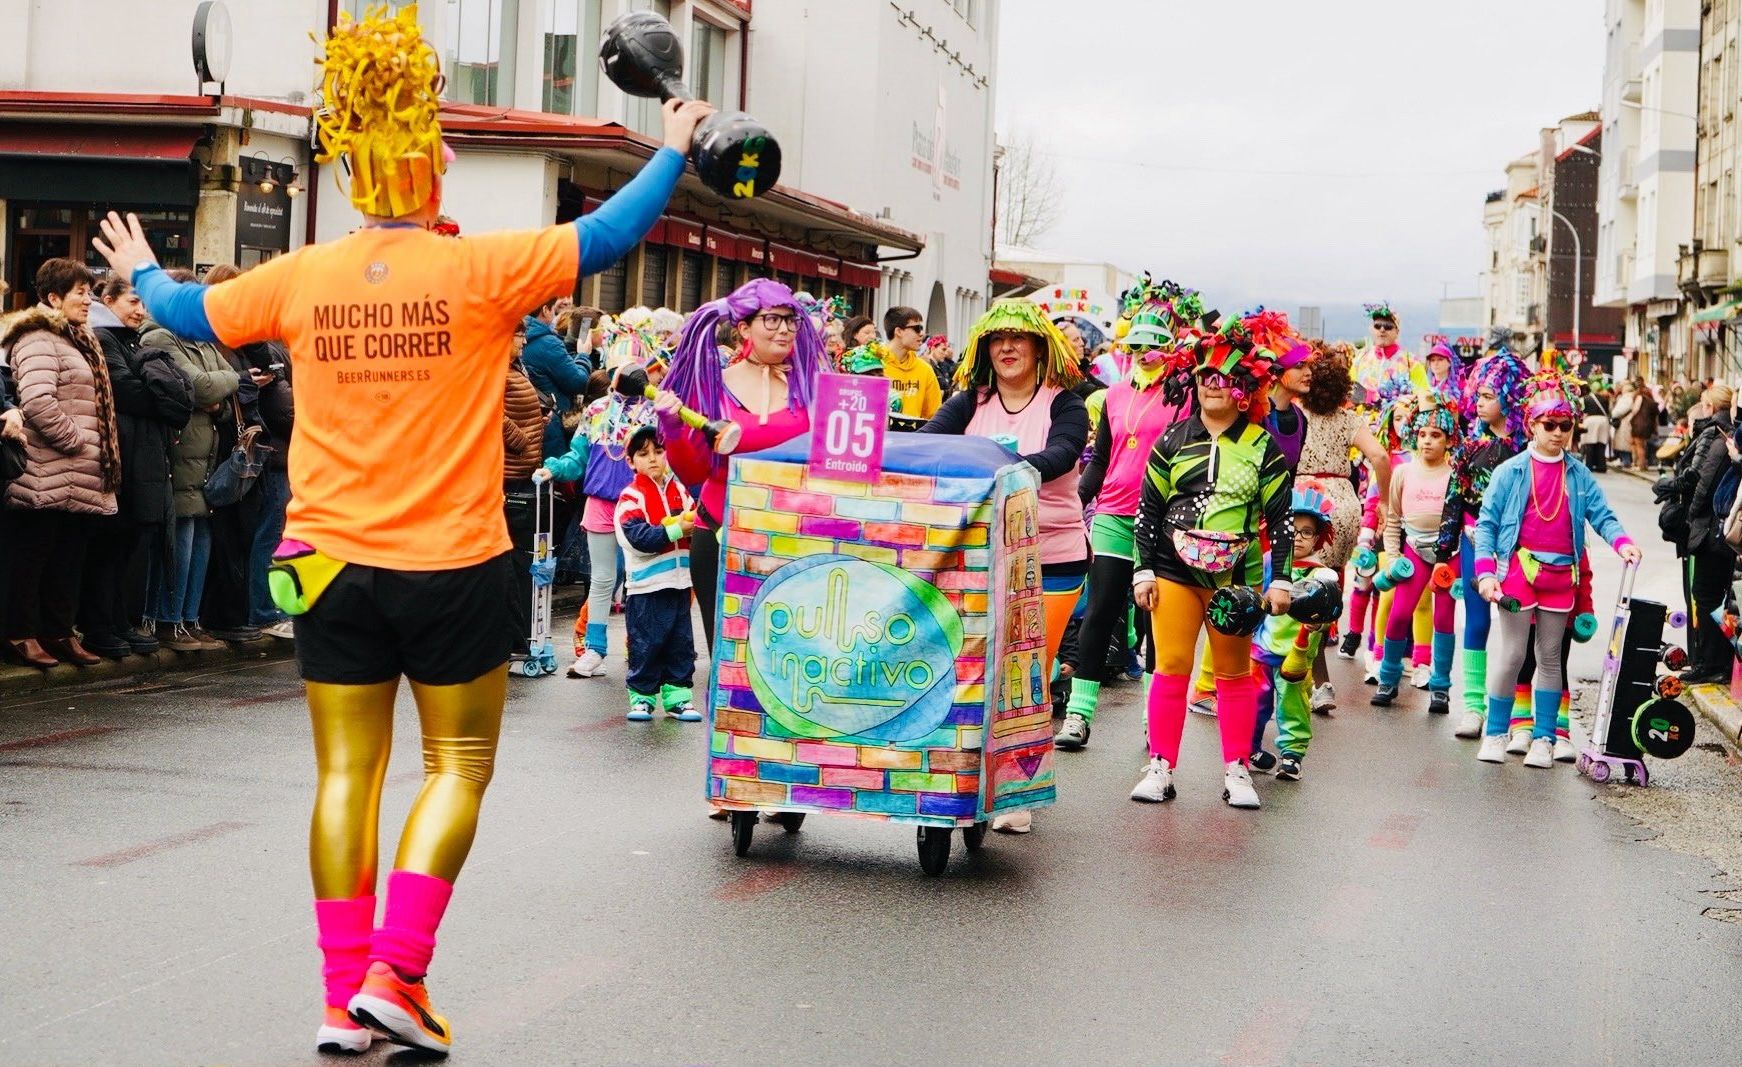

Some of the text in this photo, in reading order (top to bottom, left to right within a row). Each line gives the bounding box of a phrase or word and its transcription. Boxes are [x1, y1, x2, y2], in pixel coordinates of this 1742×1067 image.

[314, 294, 450, 330] MUCHO MÁS
[315, 331, 452, 362] QUE CORRER
[838, 396, 867, 411] +20
[826, 410, 876, 458] 05
[825, 458, 868, 472] Entroido
[1648, 718, 1669, 742] 20
